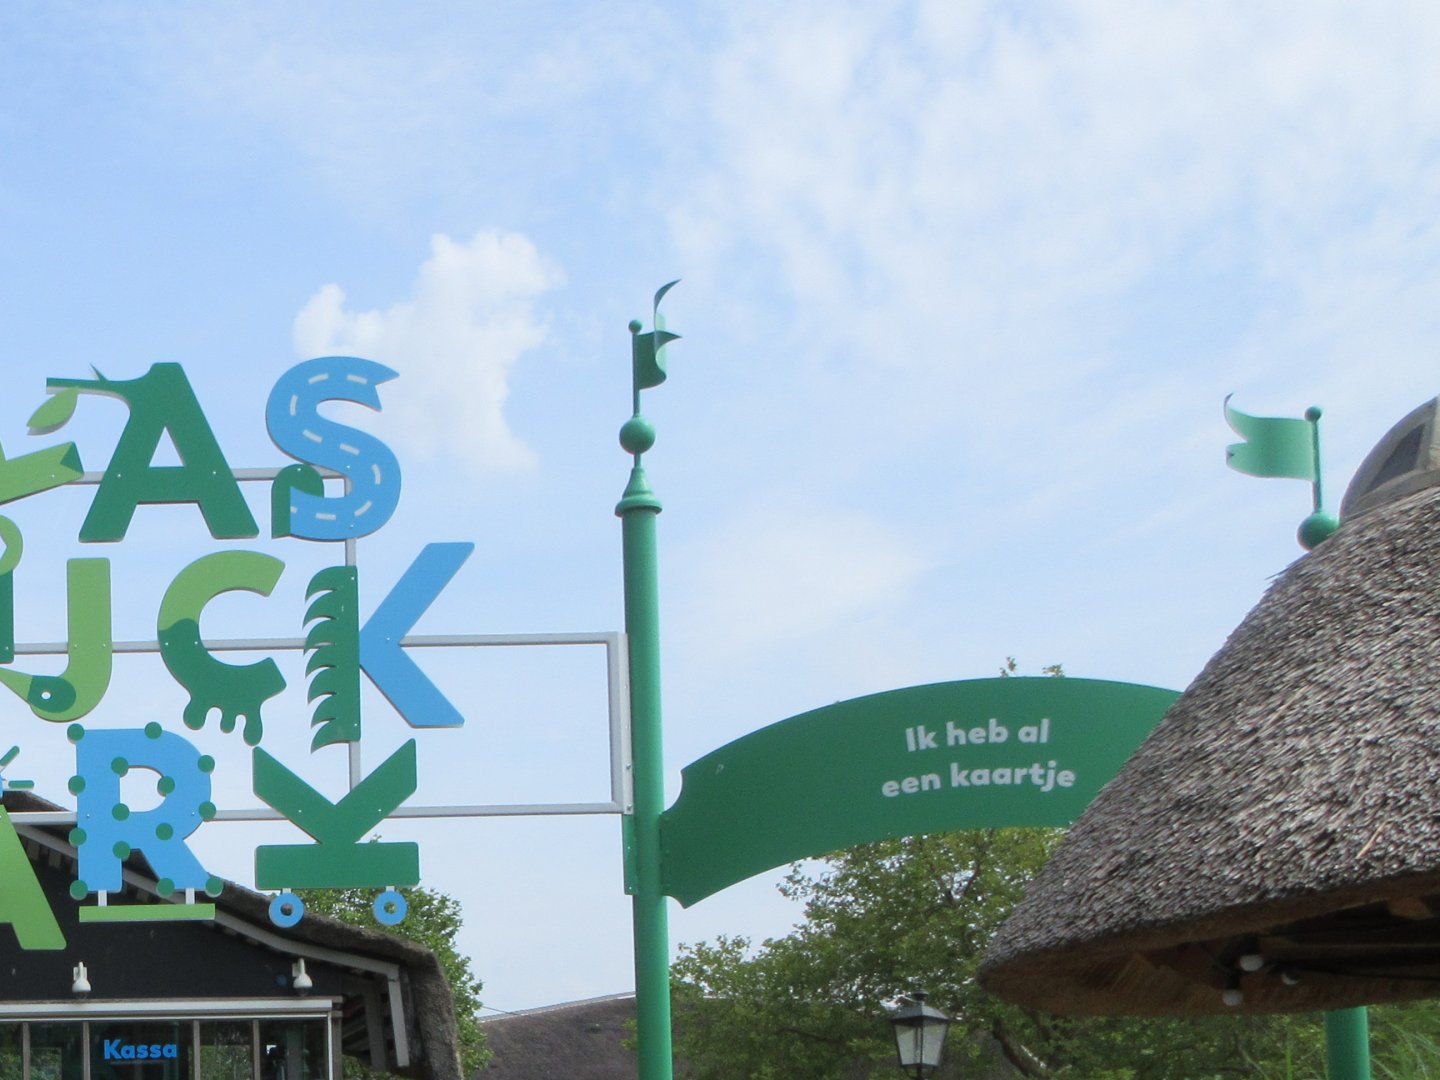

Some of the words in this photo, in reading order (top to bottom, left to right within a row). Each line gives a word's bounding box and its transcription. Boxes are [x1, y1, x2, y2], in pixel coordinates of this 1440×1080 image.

[905, 725, 938, 752] Ik
[946, 718, 1009, 746] heb
[1017, 718, 1050, 744] al
[881, 772, 942, 797] een
[950, 760, 1076, 793] kaartje
[103, 1039, 178, 1060] Kassa
